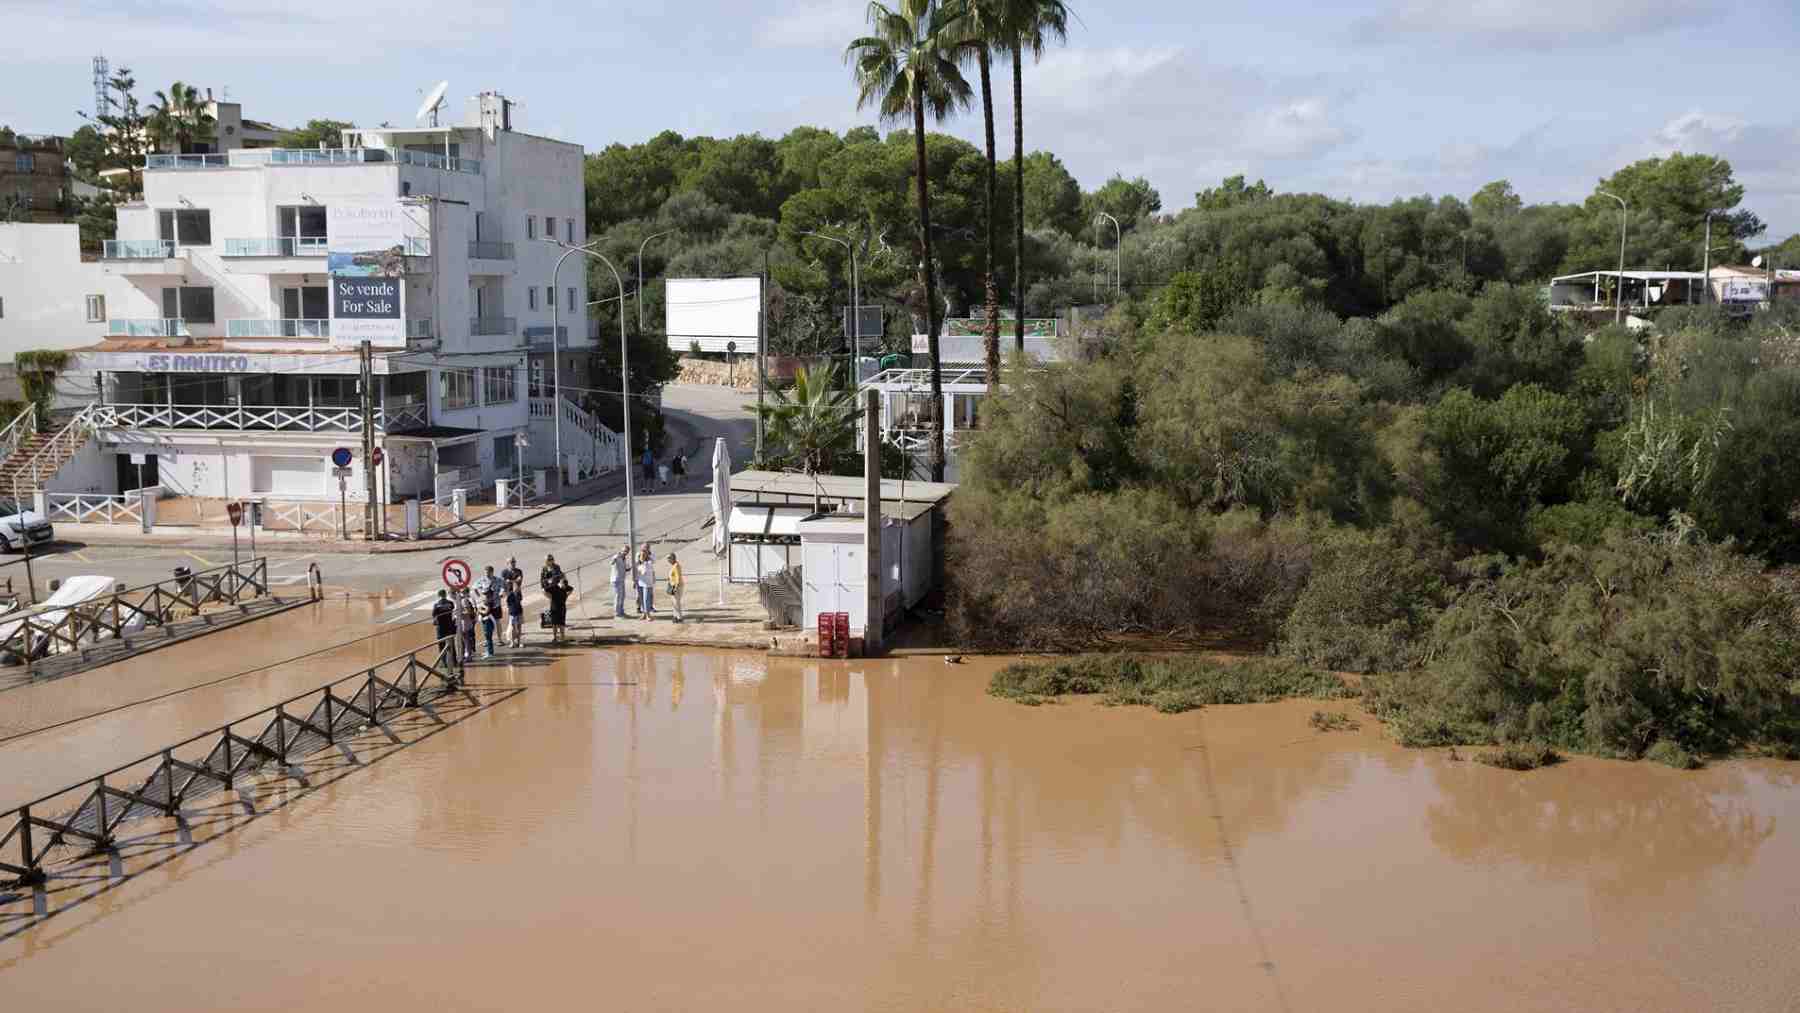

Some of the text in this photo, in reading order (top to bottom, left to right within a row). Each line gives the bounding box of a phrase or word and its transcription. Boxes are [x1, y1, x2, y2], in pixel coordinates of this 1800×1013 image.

[339, 283, 394, 296] Se vende
[342, 300, 392, 313] For Sale
[148, 356, 248, 370] ES NAUTICO
